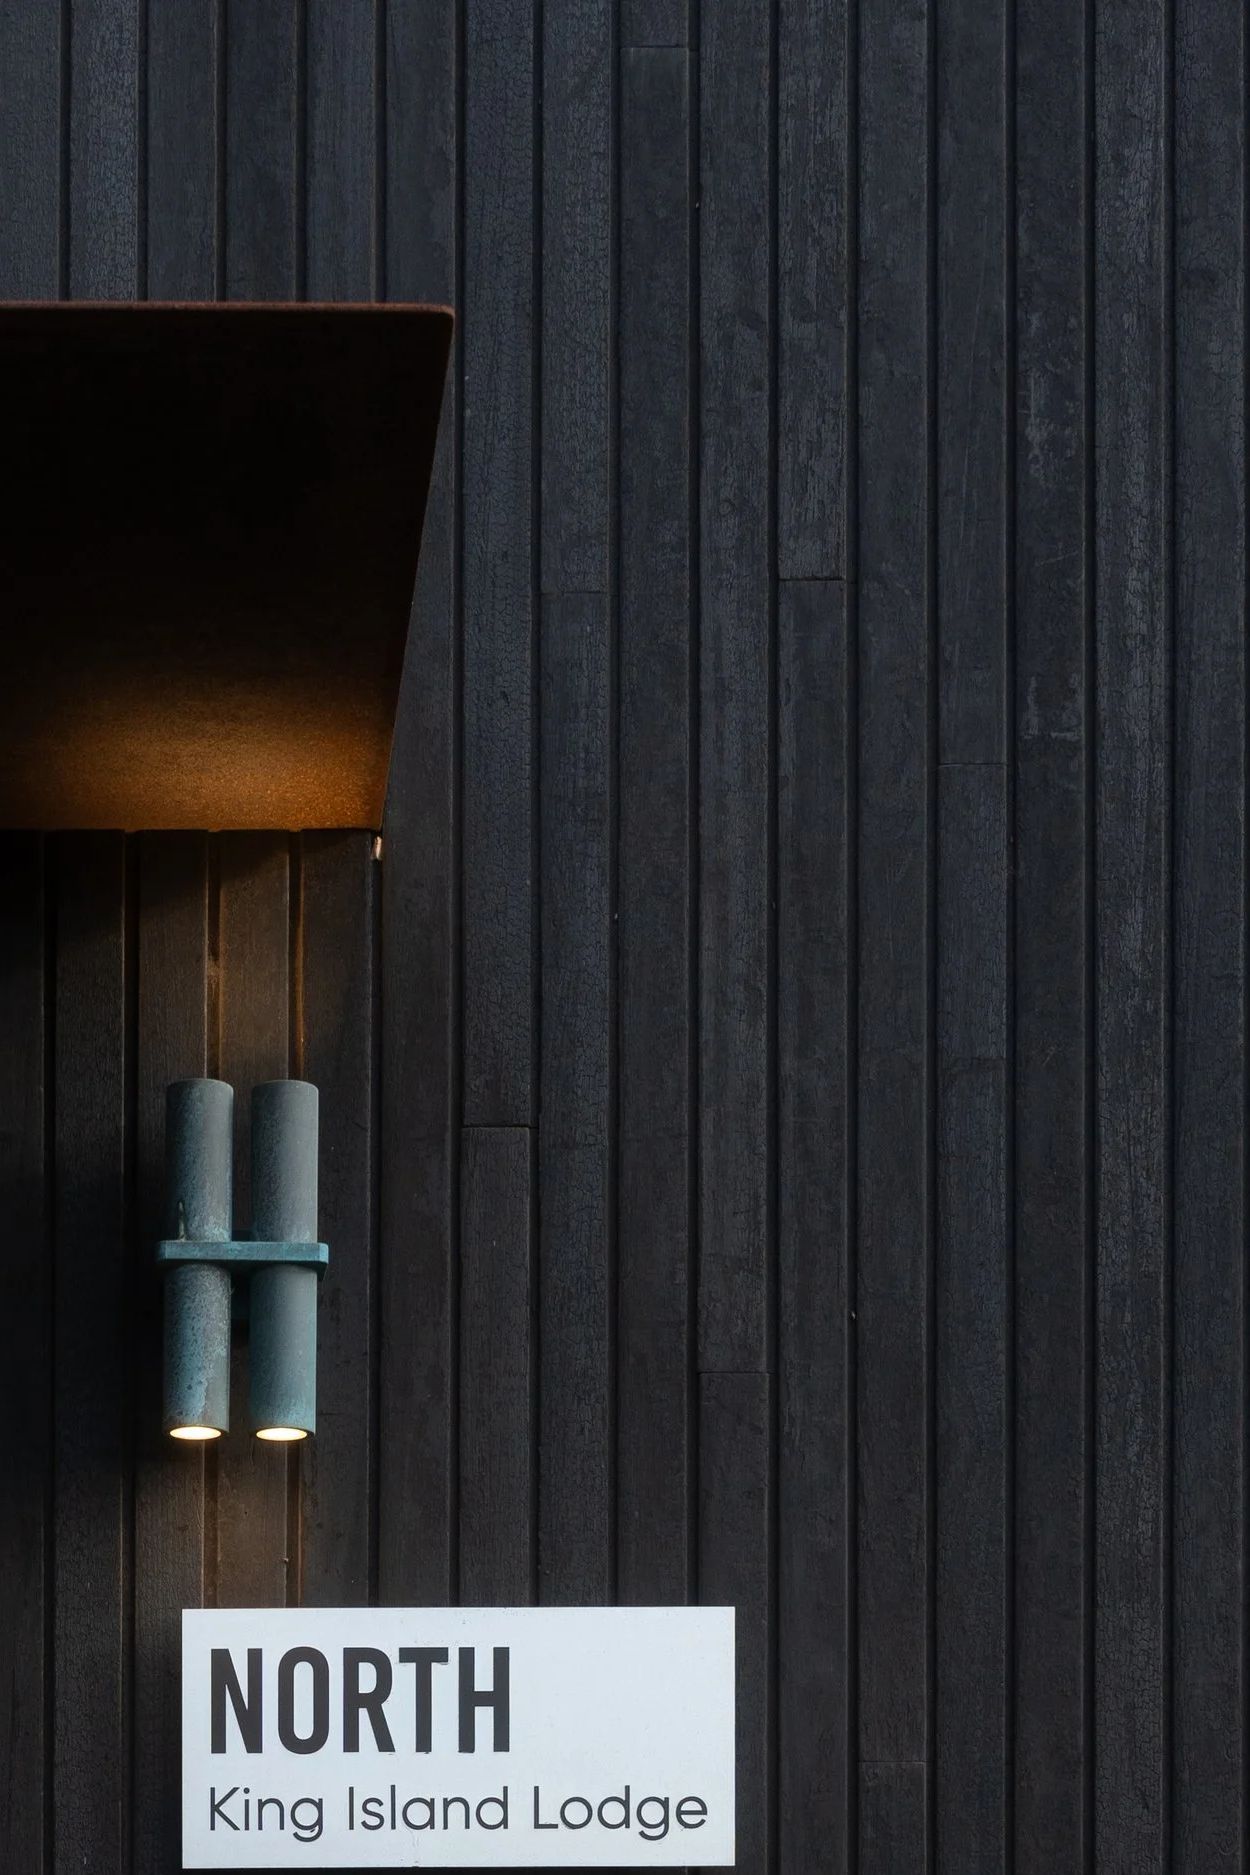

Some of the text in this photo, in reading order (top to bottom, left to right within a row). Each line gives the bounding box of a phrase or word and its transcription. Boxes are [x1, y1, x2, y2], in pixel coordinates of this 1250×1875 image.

[210, 1646, 510, 1755] NORTH
[209, 1784, 708, 1843] King Island Lodge
